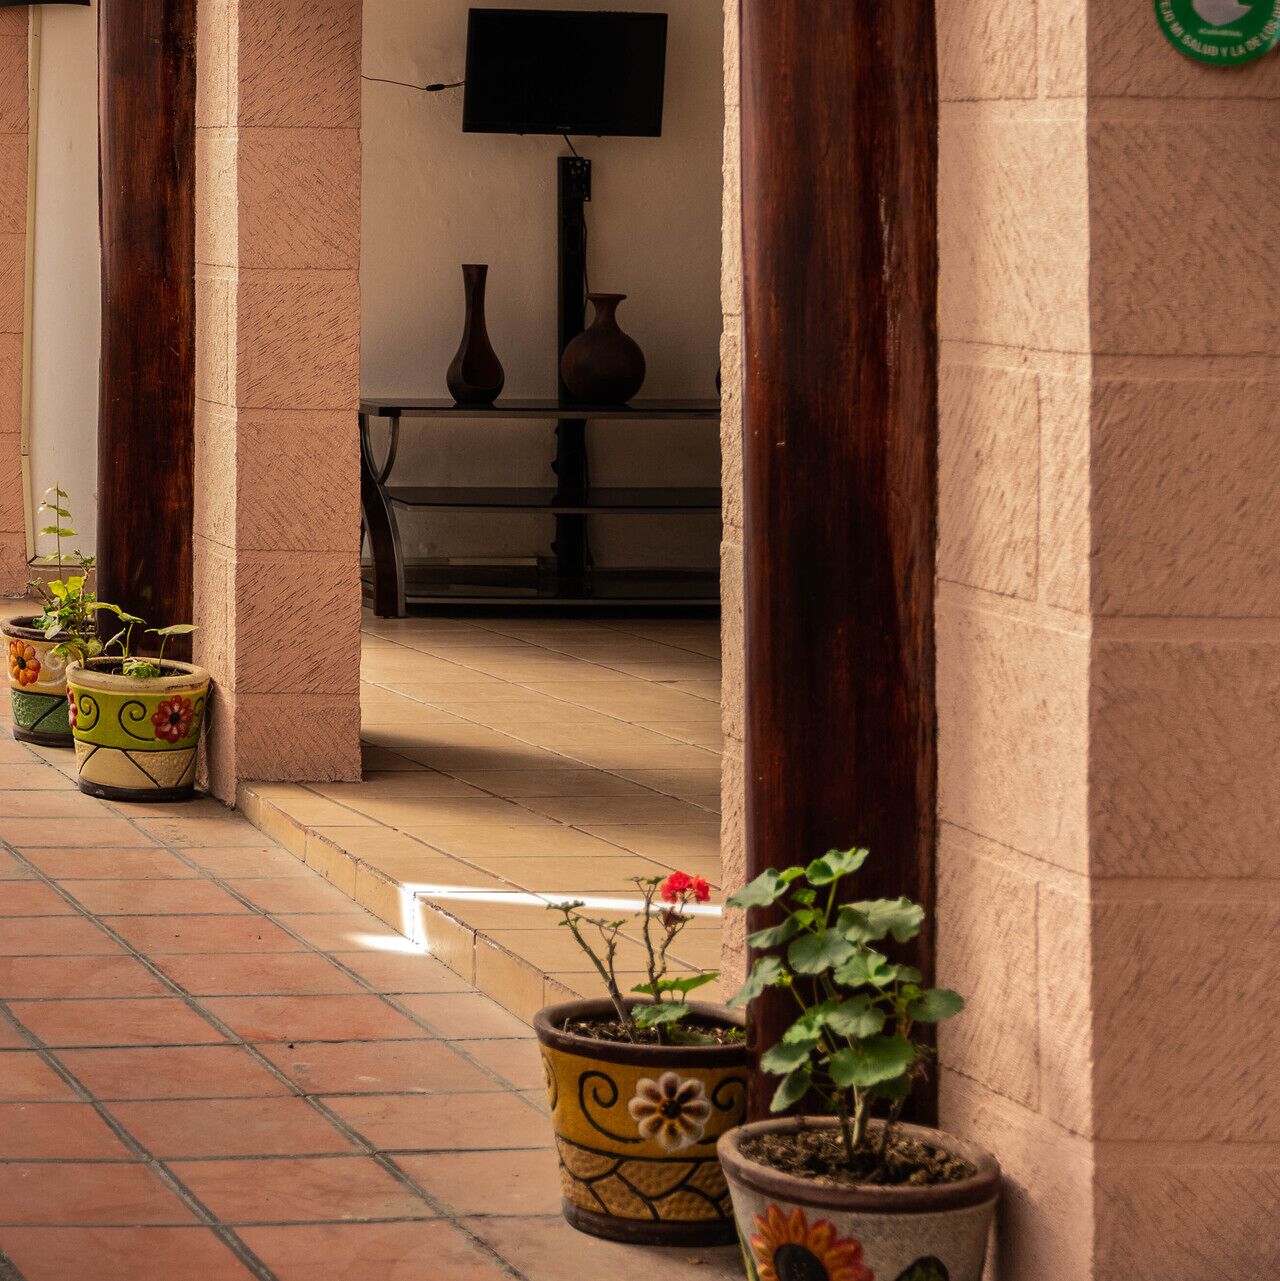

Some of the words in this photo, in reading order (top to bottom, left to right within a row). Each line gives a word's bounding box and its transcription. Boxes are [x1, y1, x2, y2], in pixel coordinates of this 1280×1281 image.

[1169, 21, 1184, 38] MI
[1183, 35, 1219, 57] SALUD
[1221, 47, 1228, 58] Y
[1230, 44, 1246, 57] LA
